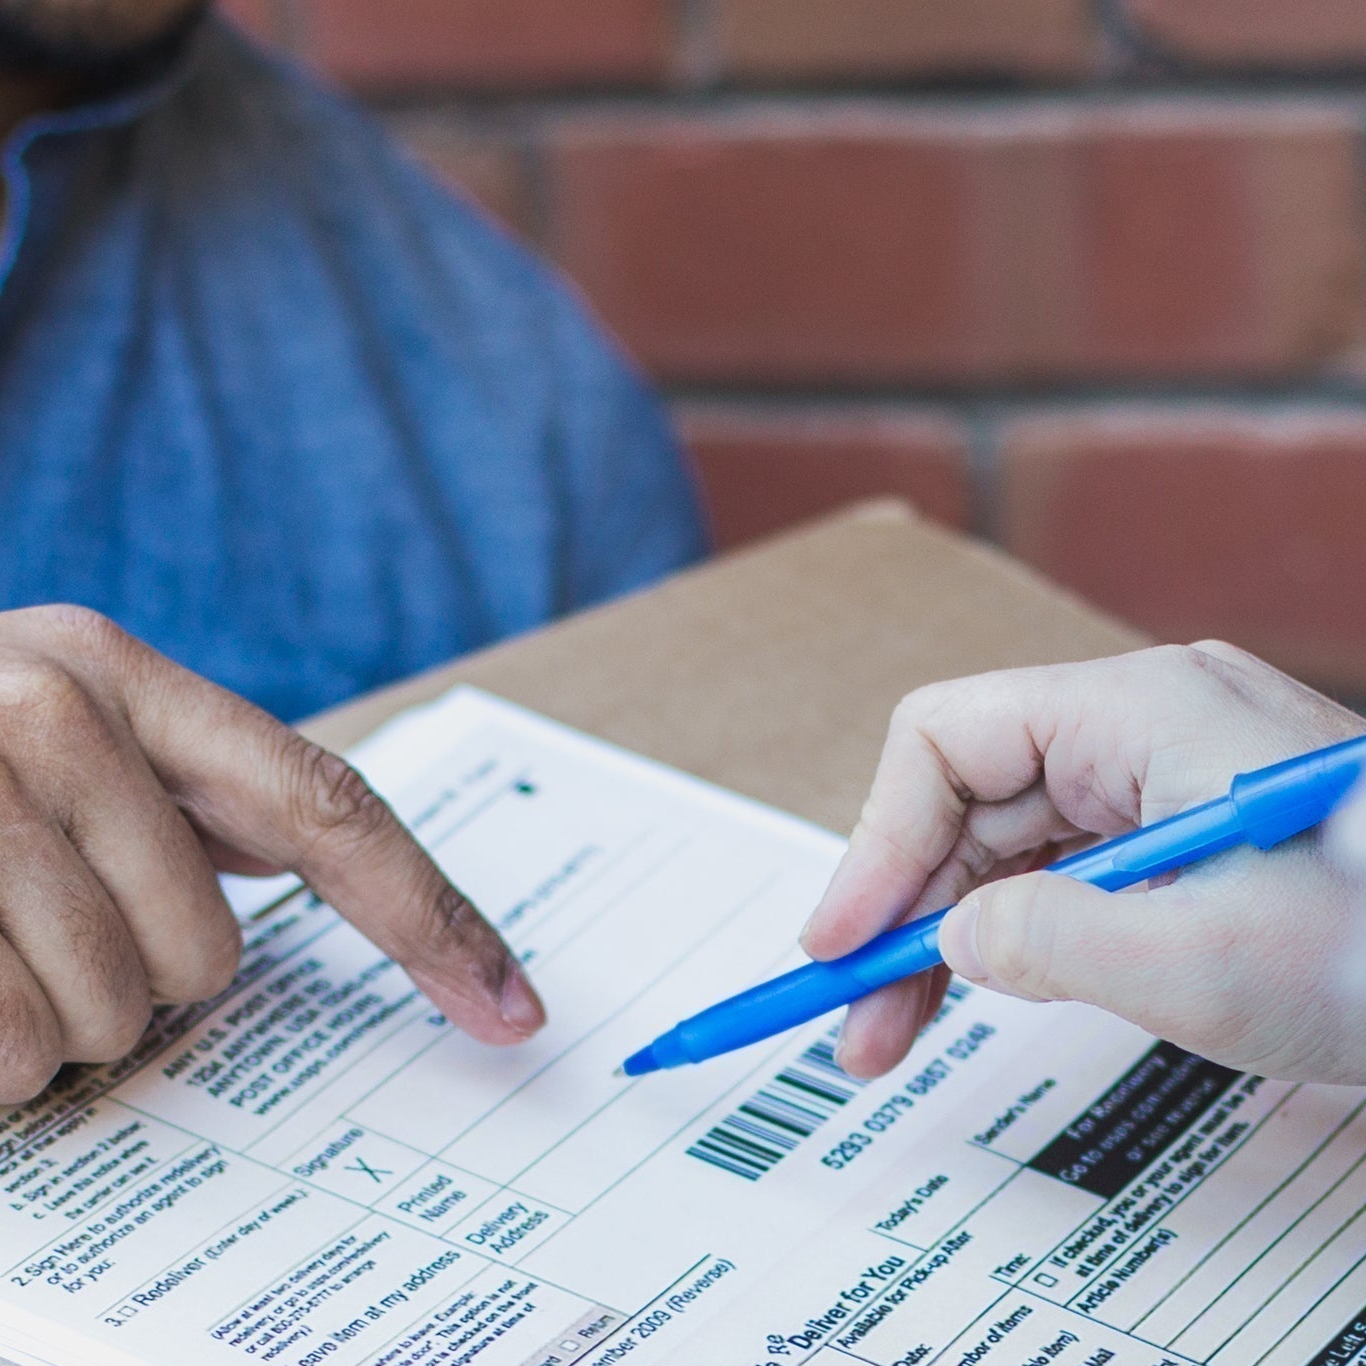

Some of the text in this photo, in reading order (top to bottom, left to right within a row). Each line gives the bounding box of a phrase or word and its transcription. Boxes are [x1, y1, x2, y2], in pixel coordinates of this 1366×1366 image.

[228, 1073, 275, 1108] POST
[270, 1029, 331, 1073] OFFICE
[820, 1023, 997, 1169] 5293 0379 6857 0248
[974, 1079, 1057, 1145] Sender's Name
[292, 1128, 366, 1177] Signature
[344, 1157, 393, 1183] X
[10, 1143, 222, 1287] 2. Sign Here to authorize redelivery
[396, 1174, 453, 1213] Printed
[418, 1190, 467, 1222] Name
[874, 1175, 949, 1232] Today's Date
[46, 1159, 229, 1285] or to authorize an agent to sign
[464, 1201, 531, 1246] Delivery
[489, 1211, 550, 1254] Address
[62, 1259, 114, 1293] for you:
[104, 1317, 127, 1327] 3.
[132, 1257, 206, 1306] Redeliver
[203, 1233, 240, 1259] (Enter
[237, 1220, 262, 1236] day
[257, 1210, 273, 1222] of
[836, 1230, 973, 1349] Available for Pick-up After
[1075, 1227, 1178, 1313] Article Number(s)
[331, 1318, 370, 1343] item
[362, 1305, 386, 1320] at
[378, 1289, 408, 1308] my
[400, 1250, 461, 1291] address
[629, 1309, 673, 1339] 2009
[664, 1258, 738, 1313] (Reverse)
[786, 1301, 852, 1349] Deliver
[839, 1280, 876, 1304] for
[861, 1255, 906, 1282] You
[994, 1305, 1034, 1333] items
[577, 1314, 616, 1339] Return
[985, 1328, 1005, 1344] of
[1040, 1330, 1080, 1359] item)
[1329, 1333, 1365, 1358] Left
